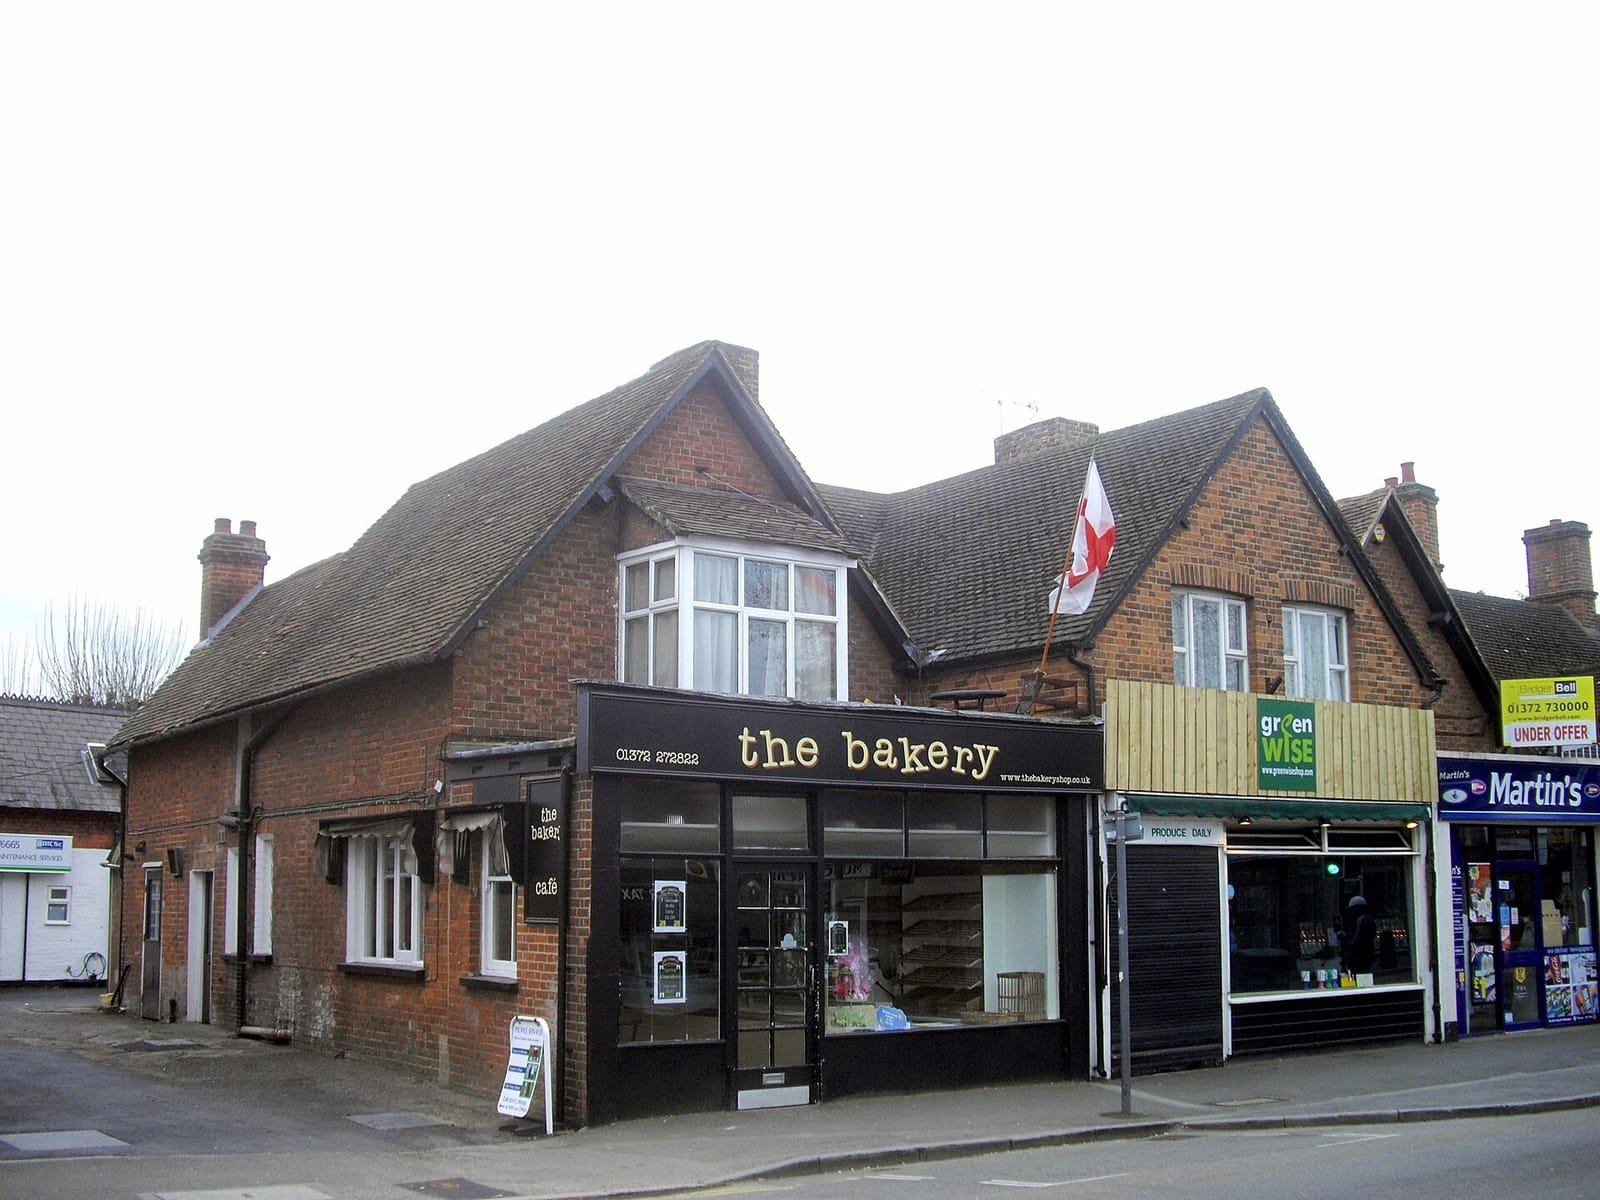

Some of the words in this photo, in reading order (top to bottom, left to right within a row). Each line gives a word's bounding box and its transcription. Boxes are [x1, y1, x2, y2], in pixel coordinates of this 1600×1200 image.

[1556, 682, 1576, 692] Bell
[1508, 703, 1541, 714] 01372
[1545, 701, 1589, 712] 730000
[1261, 713, 1313, 737] green
[1514, 726, 1551, 742] UNDER
[1554, 724, 1588, 740] OFFER
[616, 748, 651, 763] 01372
[656, 751, 699, 766] 272822
[737, 726, 821, 769] the
[841, 731, 1000, 781] bakery
[1261, 736, 1313, 763] WISE
[999, 773, 1091, 785] www.thebakeryshop.co.uk
[1439, 770, 1470, 780] Martin's
[1488, 772, 1582, 807] Martin's
[541, 807, 557, 823] the
[1151, 828, 1187, 838] PRODUCE
[1192, 828, 1212, 838] DAILY
[535, 877, 558, 895] café
